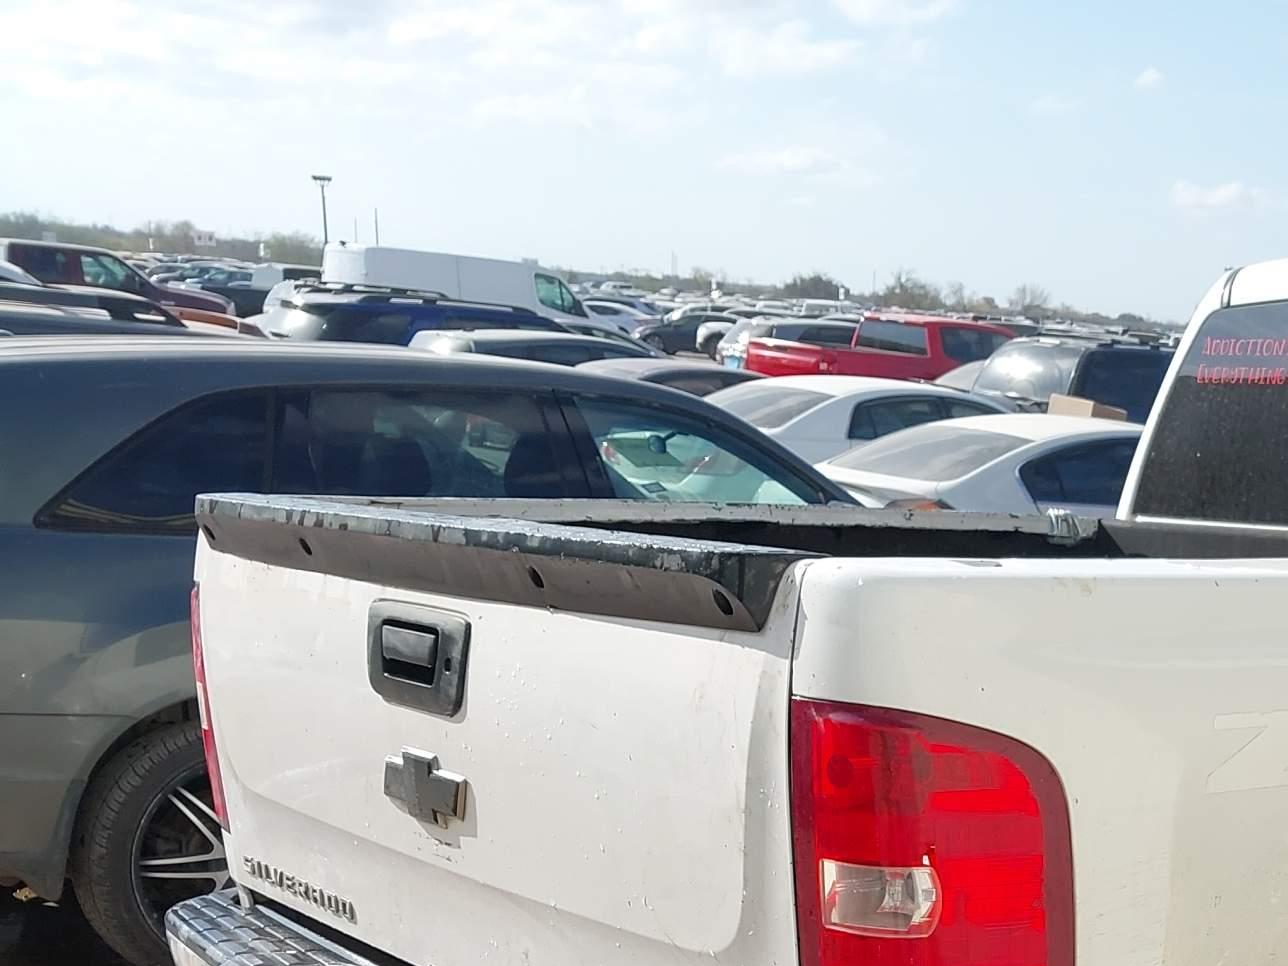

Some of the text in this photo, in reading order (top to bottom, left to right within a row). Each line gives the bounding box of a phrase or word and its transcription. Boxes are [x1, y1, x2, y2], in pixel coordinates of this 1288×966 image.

[1203, 336, 1286, 356] ADDICTION
[1196, 363, 1287, 385] EVERYTHING
[243, 855, 358, 923] SILVERADO
